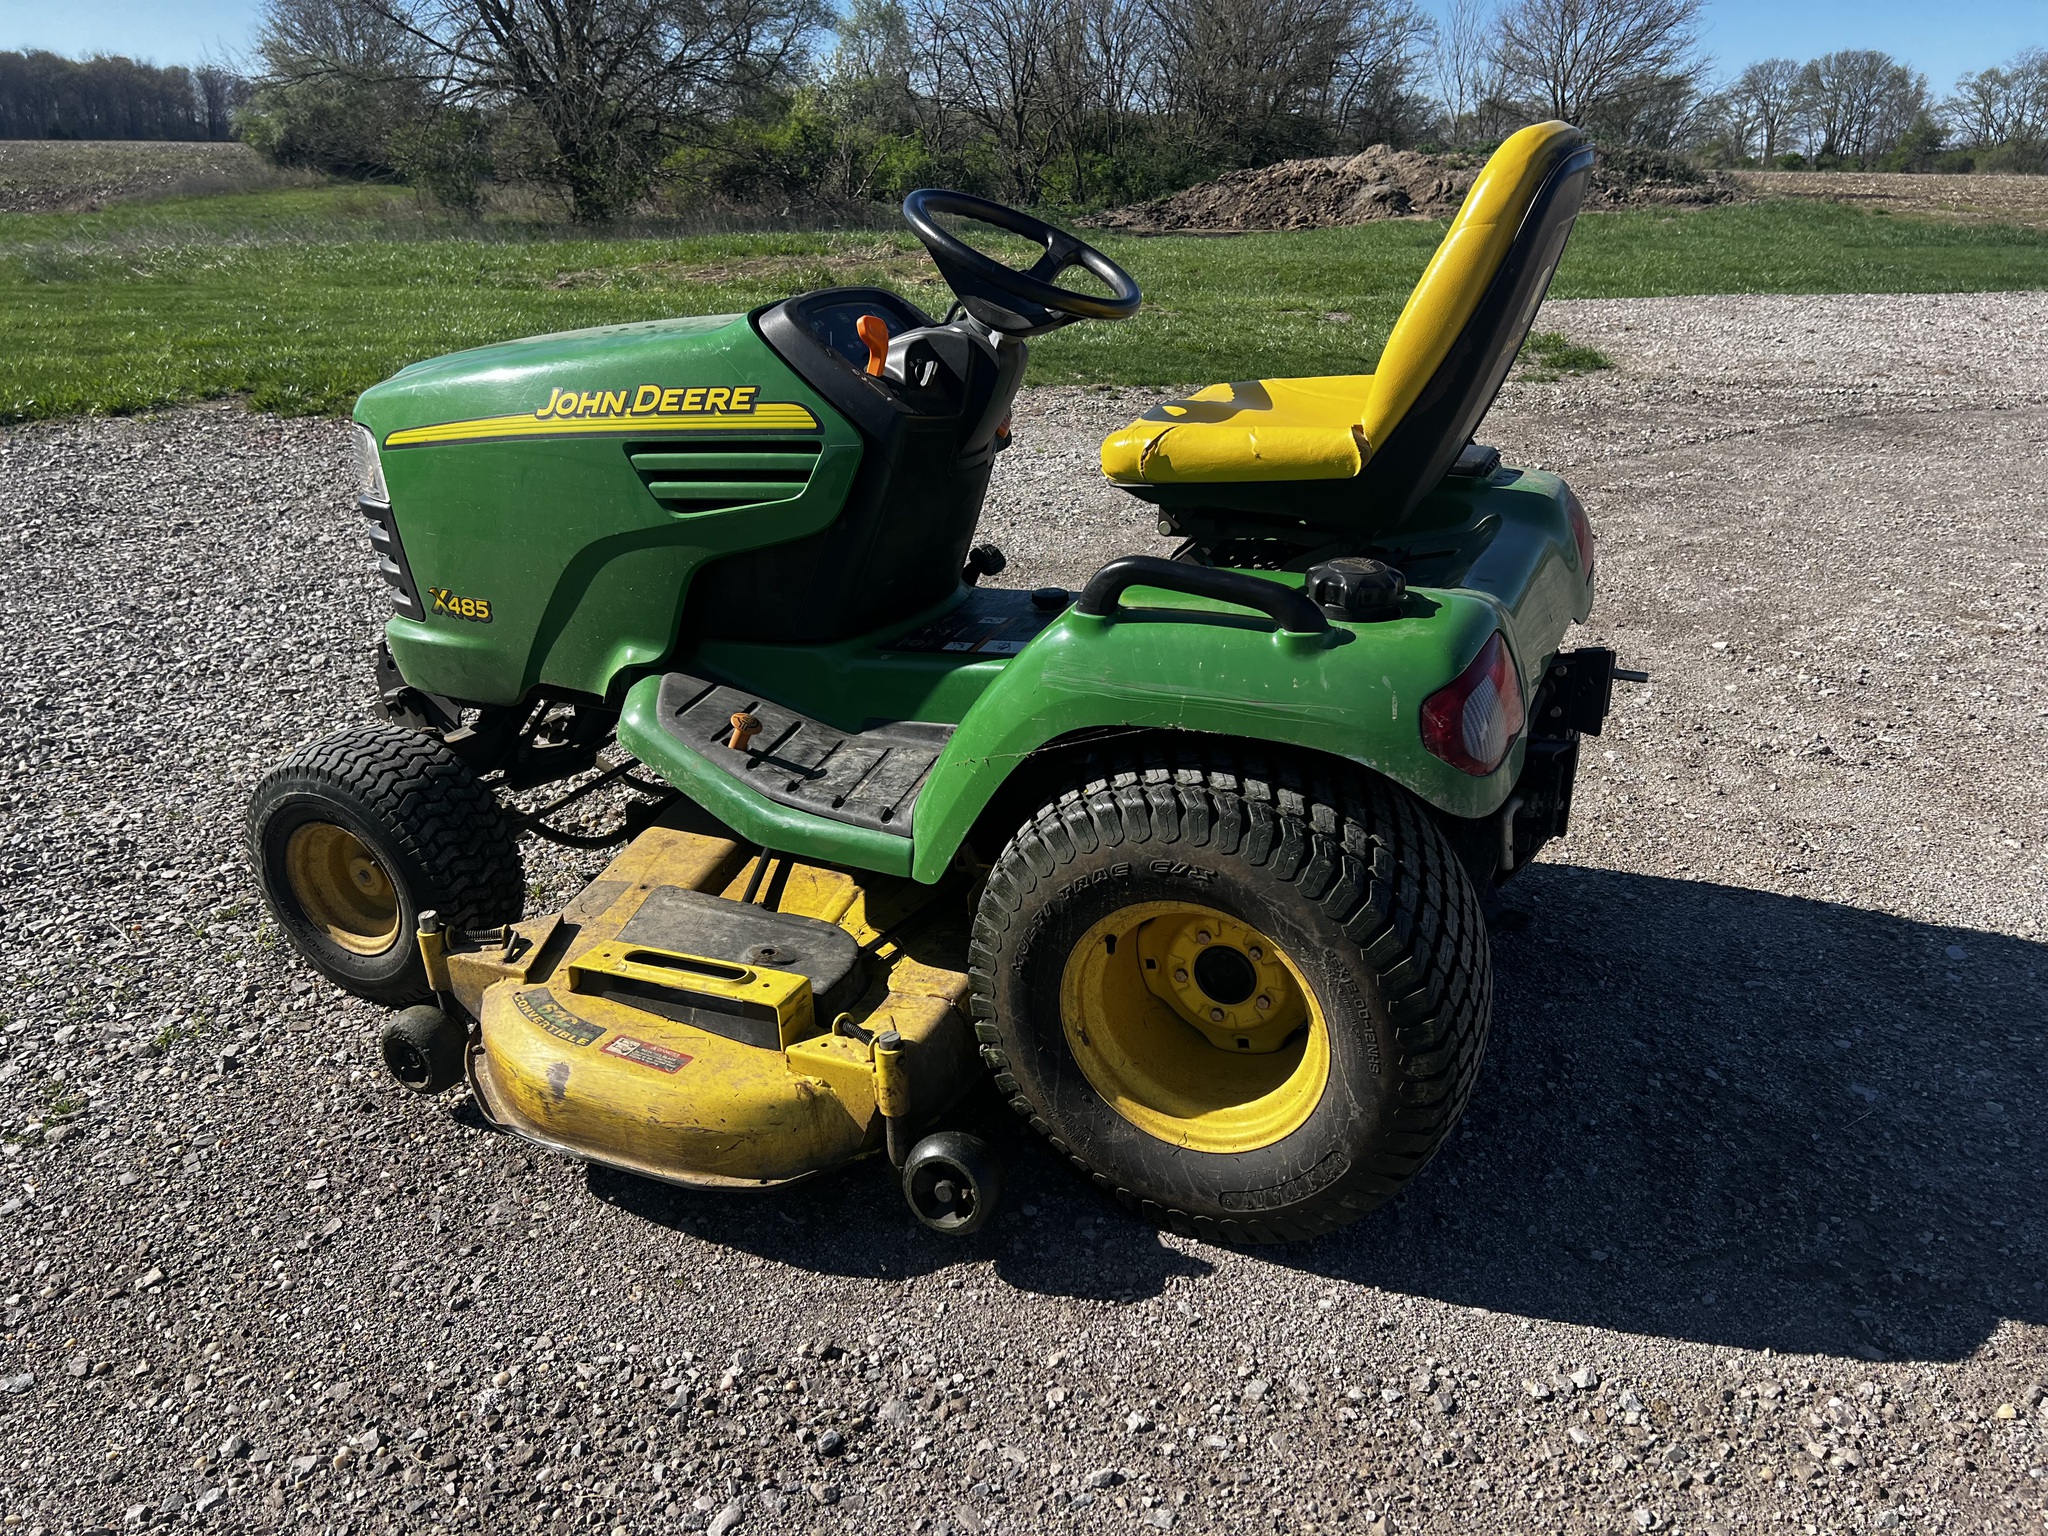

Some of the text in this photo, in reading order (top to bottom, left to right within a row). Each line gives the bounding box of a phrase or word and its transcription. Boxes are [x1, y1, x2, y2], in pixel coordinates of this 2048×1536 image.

[535, 384, 757, 417] JOHN DEERE
[427, 587, 491, 621] X485
[1010, 900, 1053, 980] MULTI
[1057, 861, 1132, 901] TRAC
[514, 994, 590, 1046] CONVERTIBLE
[1238, 1162, 1337, 1211] TITAN
